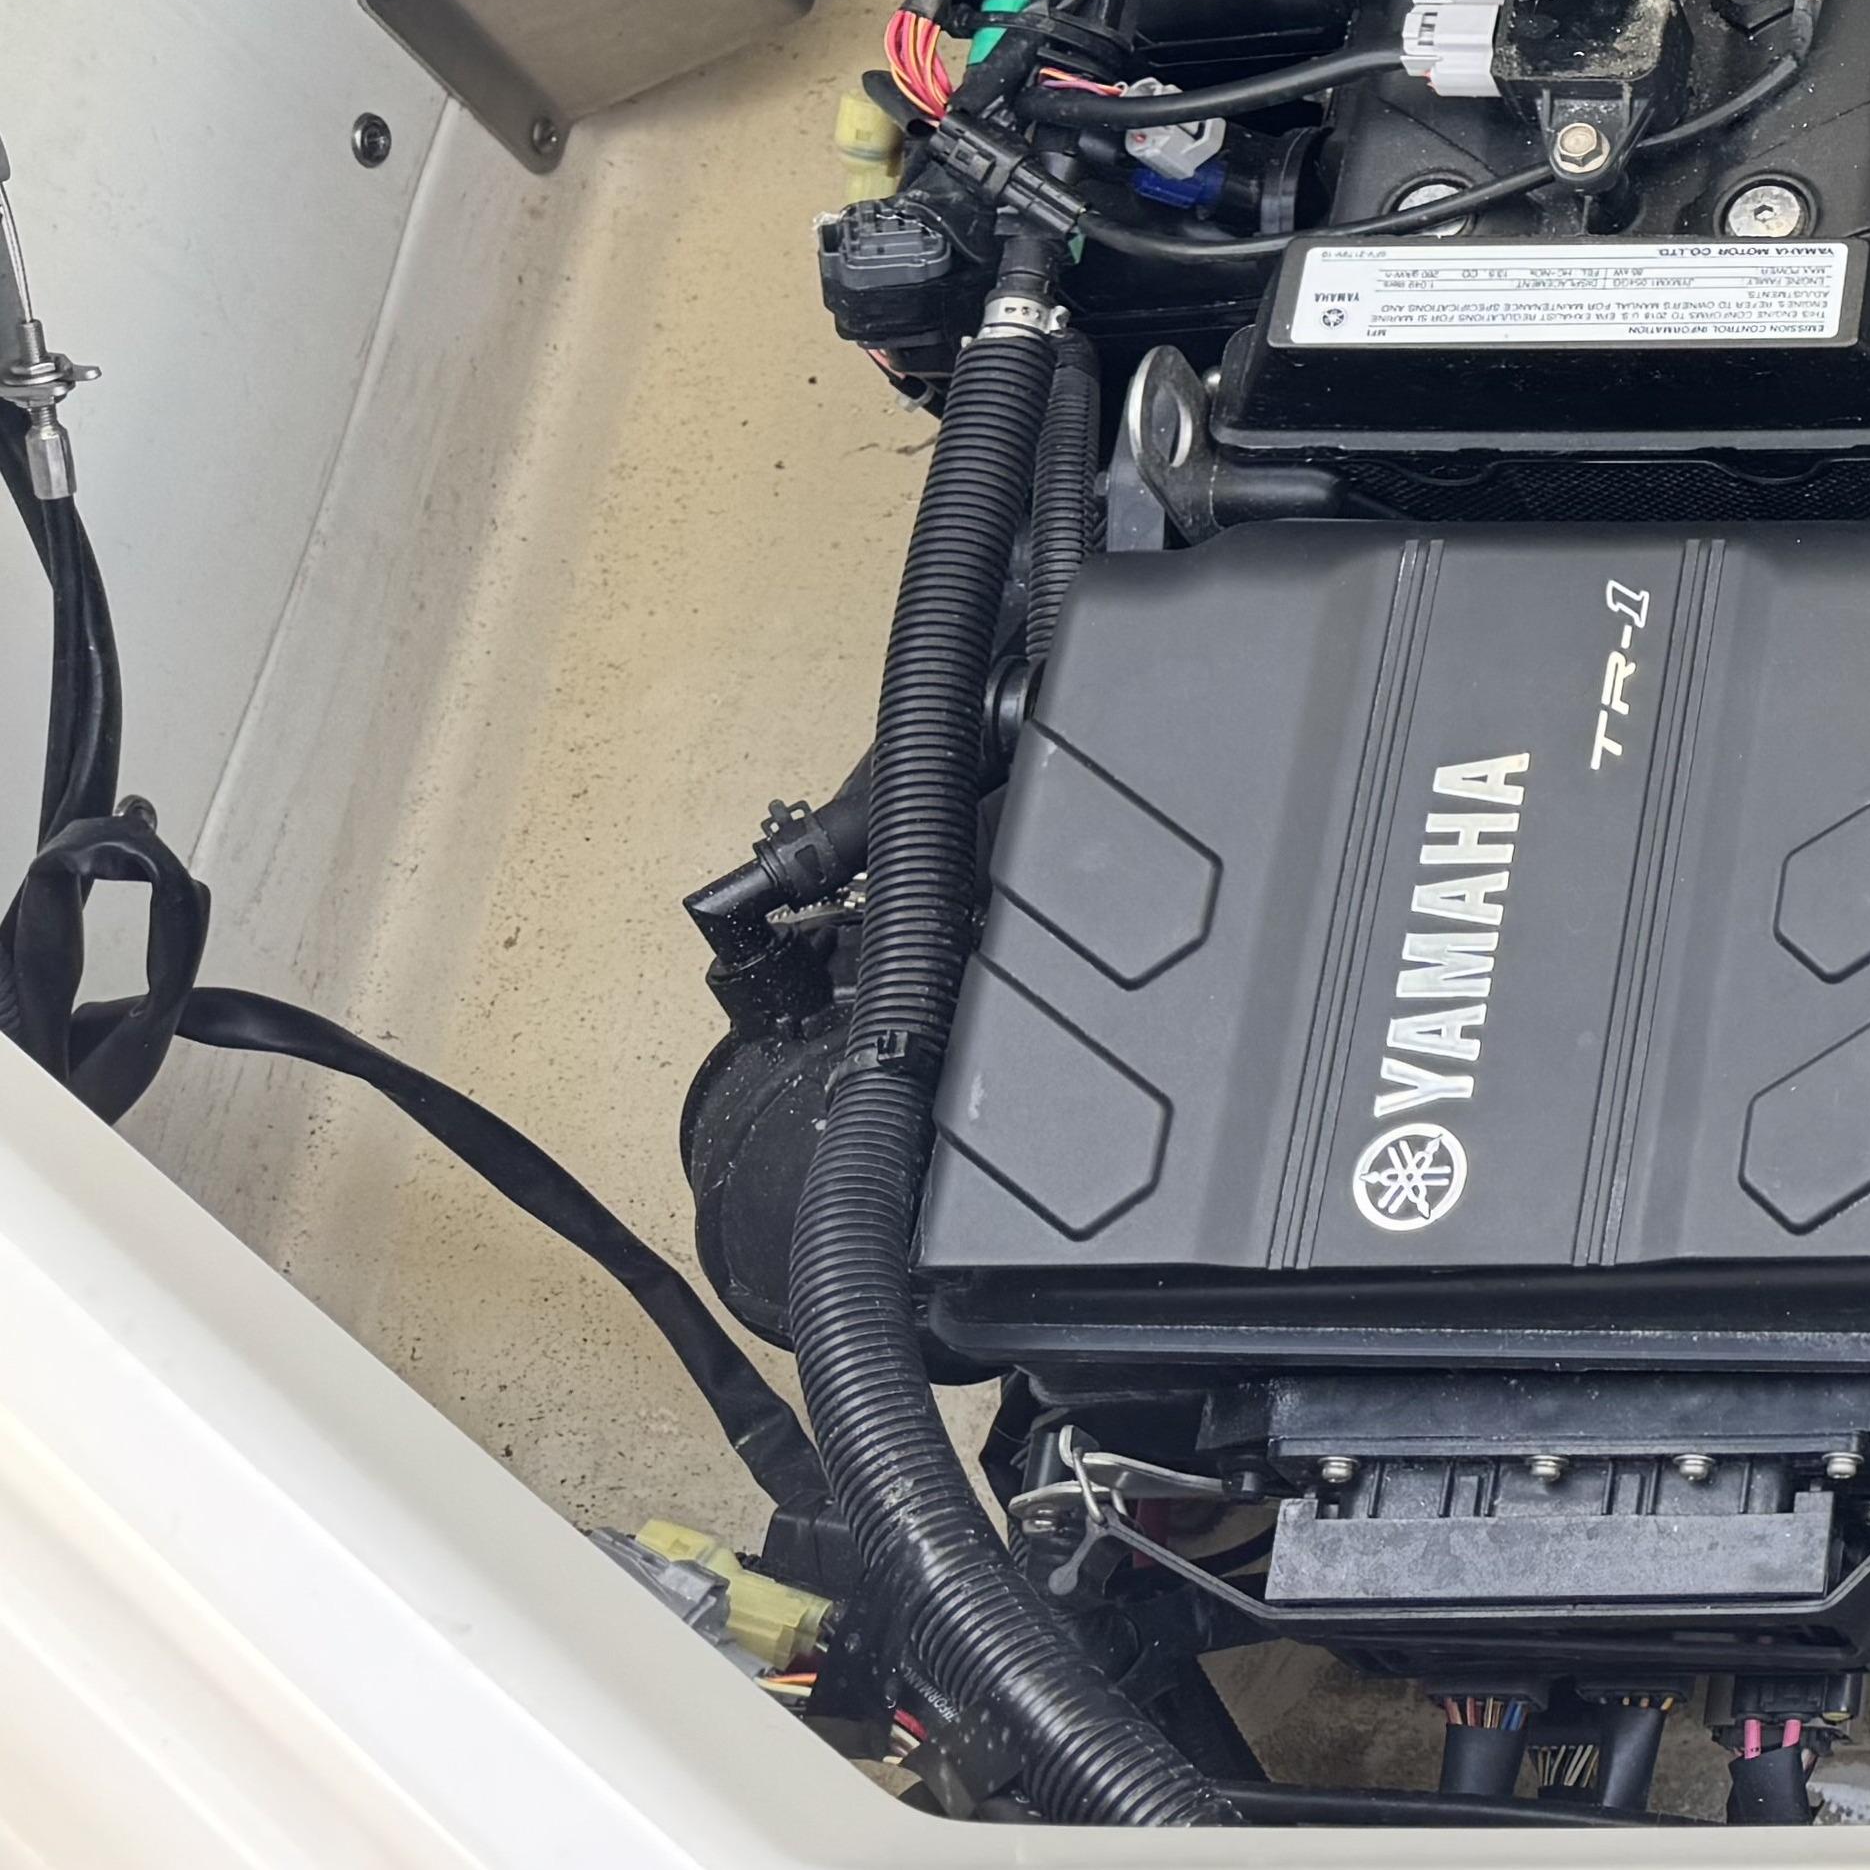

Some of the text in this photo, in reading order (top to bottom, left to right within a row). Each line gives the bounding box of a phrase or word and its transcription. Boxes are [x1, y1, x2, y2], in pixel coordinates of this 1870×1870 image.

[1717, 247, 1768, 255] MOTOR
[1312, 292, 1360, 301] YAMAHA
[1627, 325, 1708, 334] INFORMATION
[1711, 324, 1766, 333] CONTROL
[1769, 323, 1824, 332] EMISSION
[1374, 751, 1531, 1118] YAMAHA
